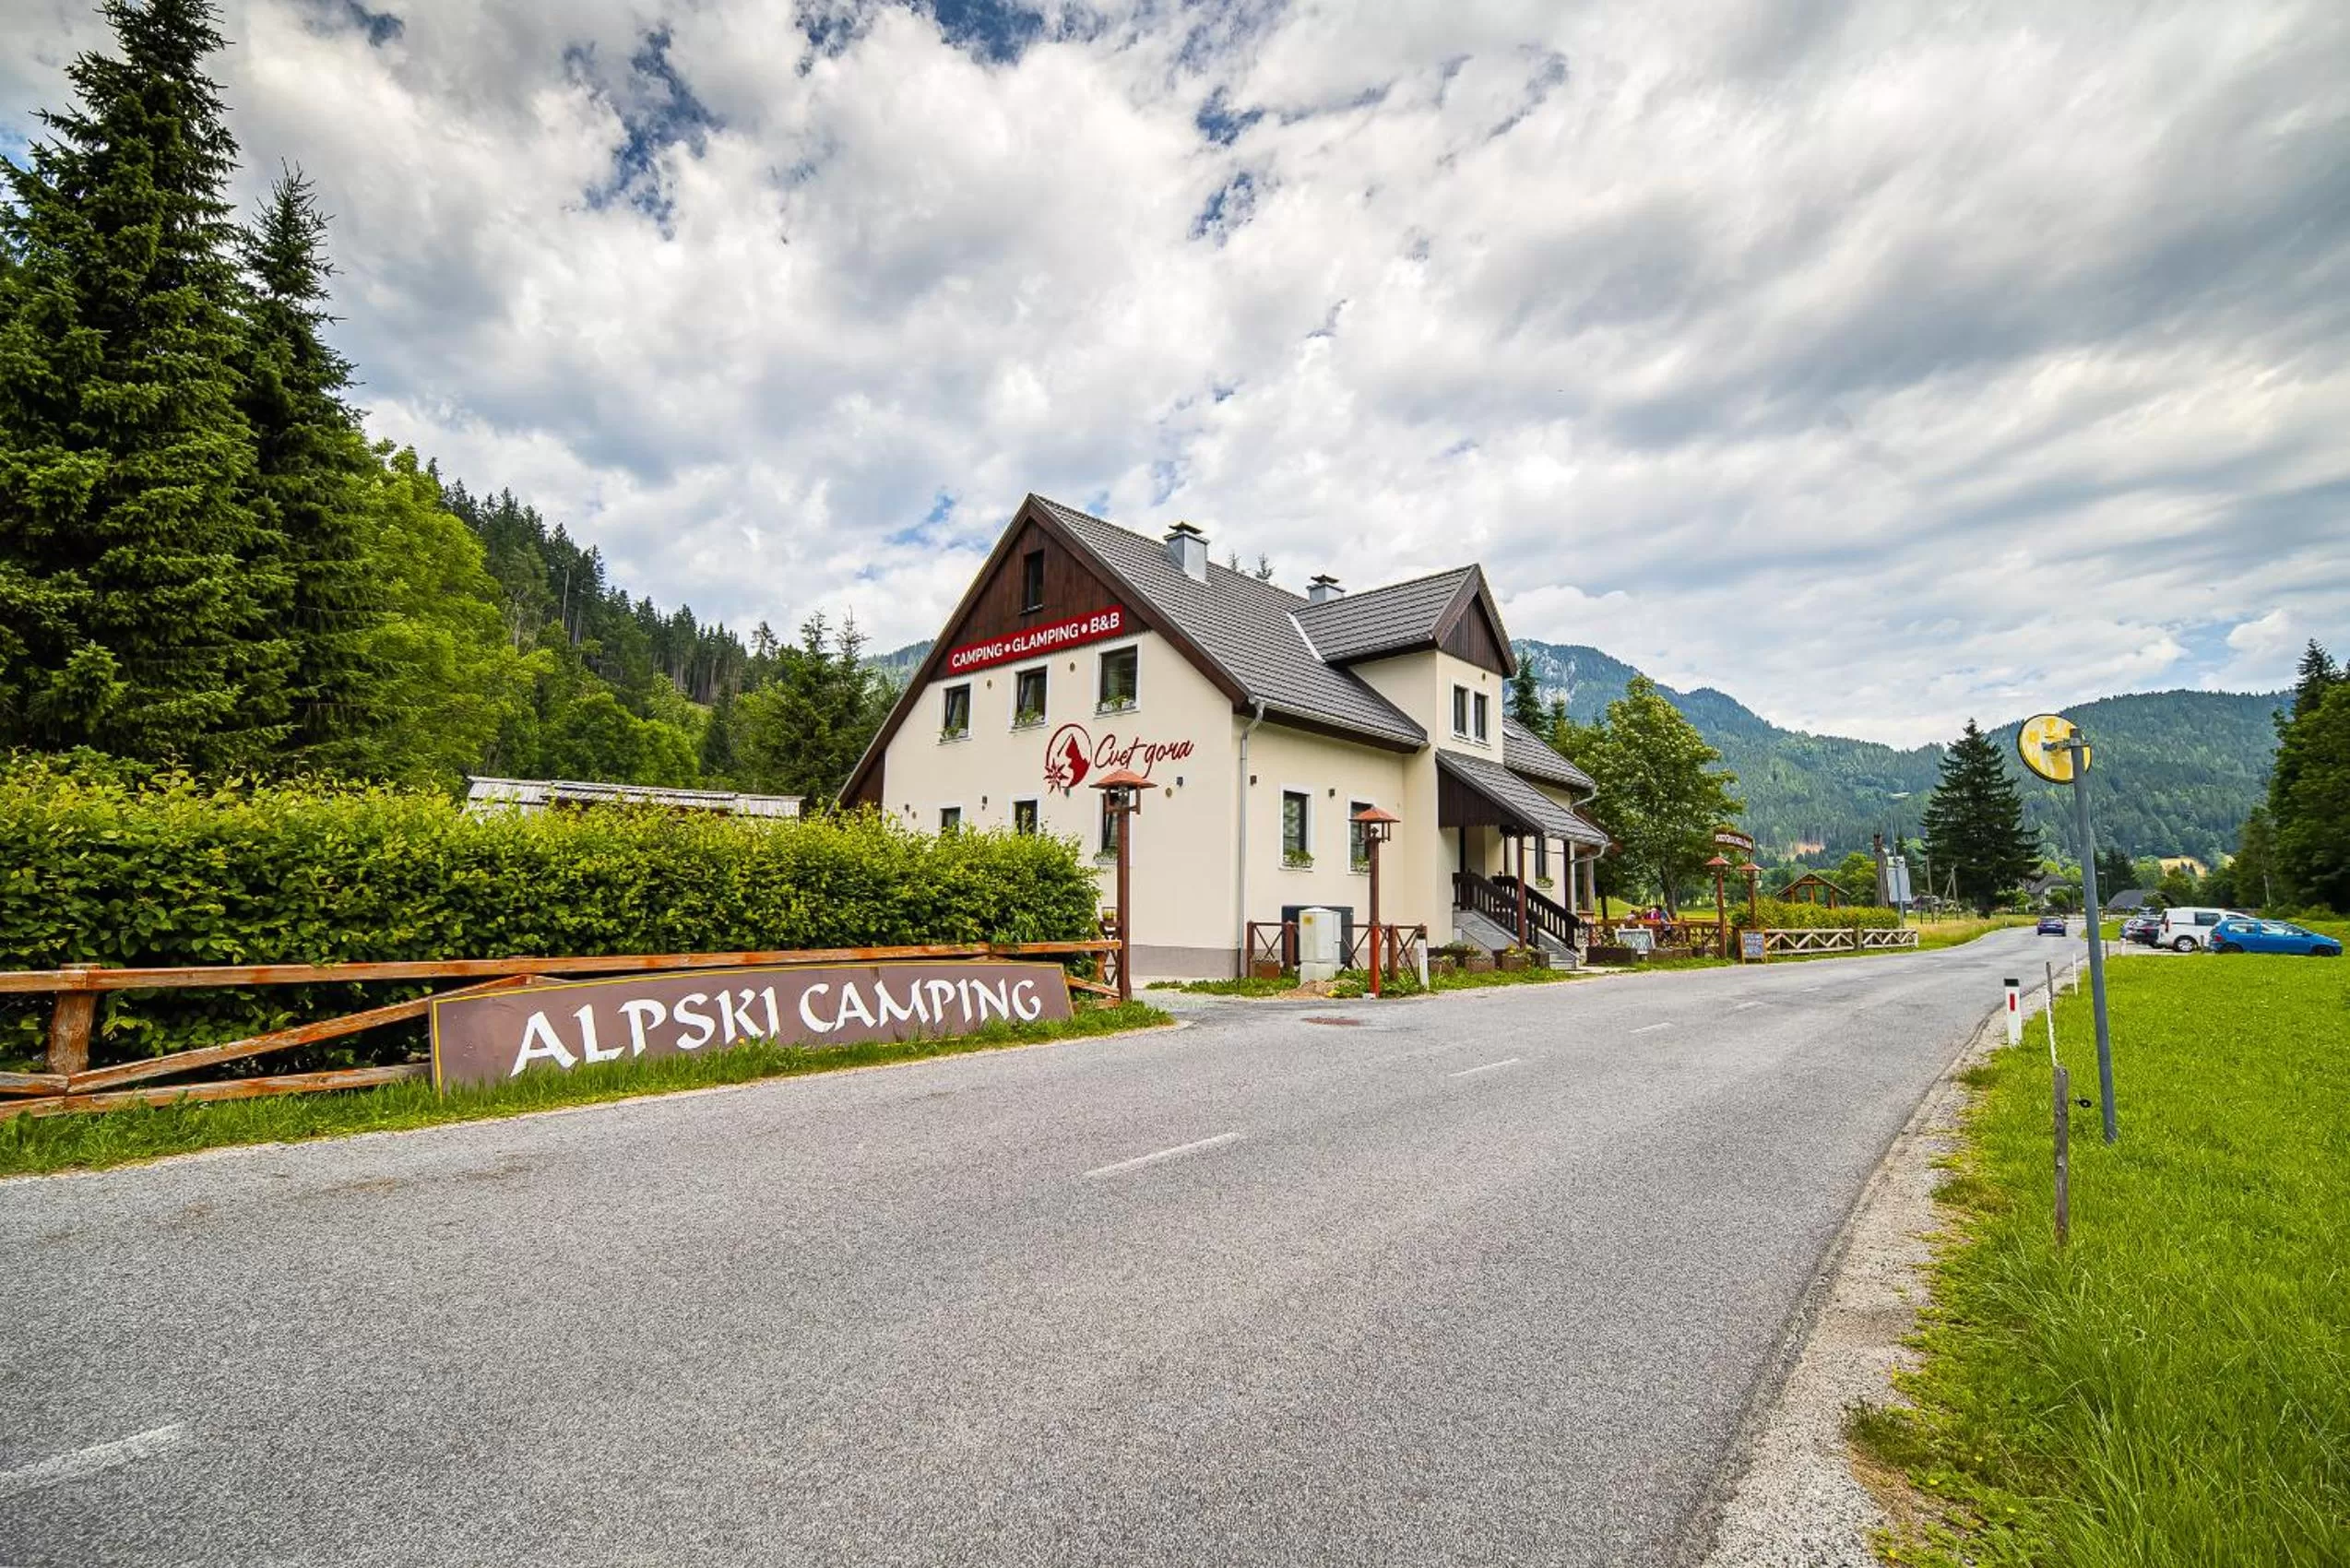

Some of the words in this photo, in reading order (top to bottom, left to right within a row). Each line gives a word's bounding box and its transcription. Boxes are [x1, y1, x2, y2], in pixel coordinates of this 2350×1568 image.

[952, 643, 1003, 668] CAMPING
[1011, 622, 1079, 653] GLAMPING
[1089, 612, 1120, 634] B&B
[1142, 740, 1194, 779] gora
[510, 986, 781, 1077] ALPSKI
[799, 978, 1041, 1033] CAMPING
